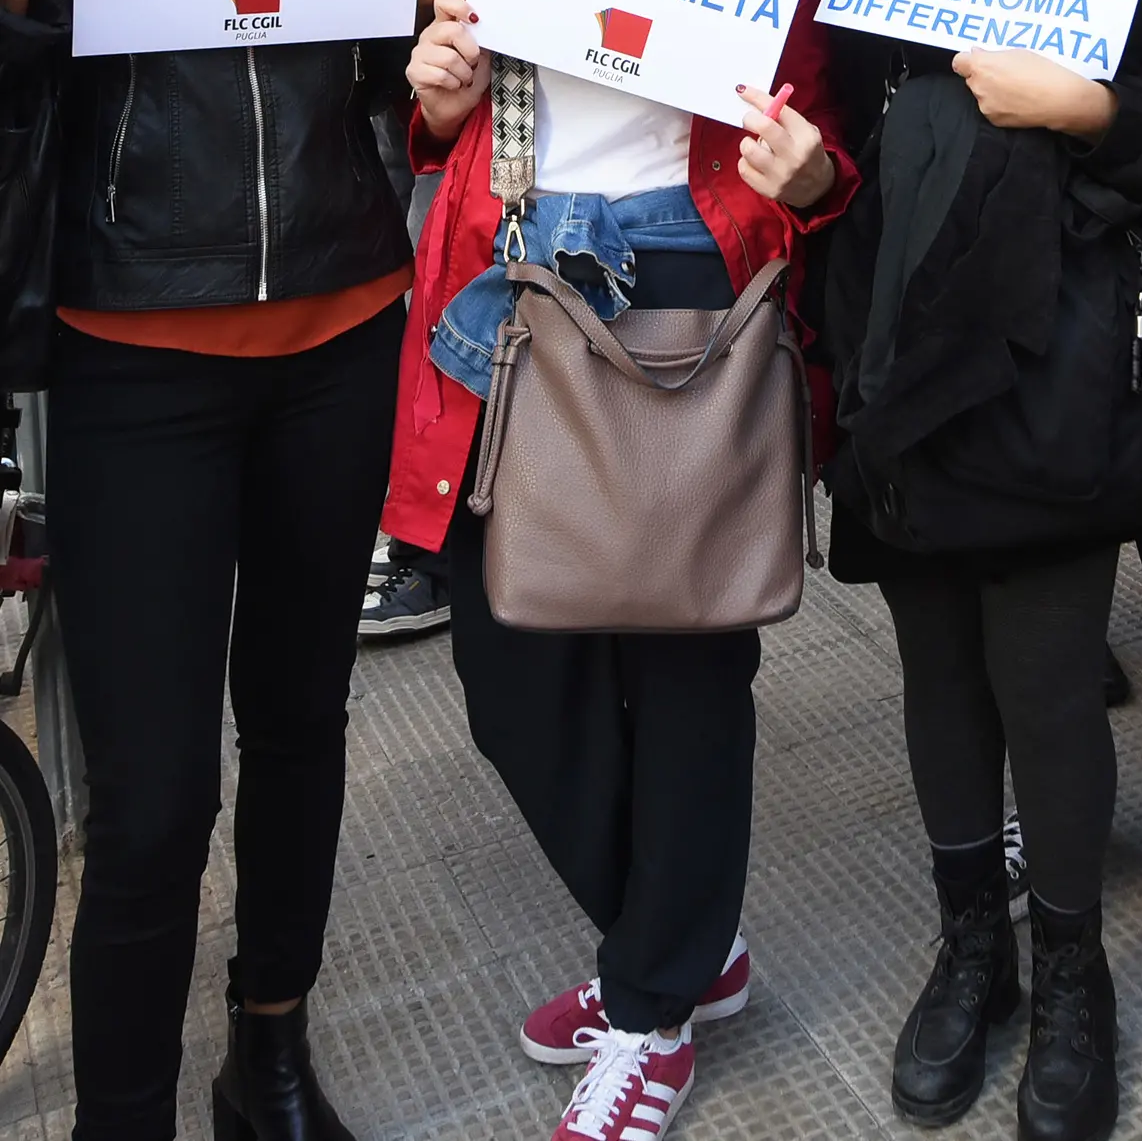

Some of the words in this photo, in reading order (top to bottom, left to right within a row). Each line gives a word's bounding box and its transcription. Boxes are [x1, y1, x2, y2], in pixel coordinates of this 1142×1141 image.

[224, 18, 248, 31] FLC
[251, 16, 282, 30] CGIL
[235, 32, 267, 41] PUGLIA
[585, 48, 608, 67] FLC
[611, 56, 641, 77] CGIL
[592, 68, 624, 83] PUGLIA
